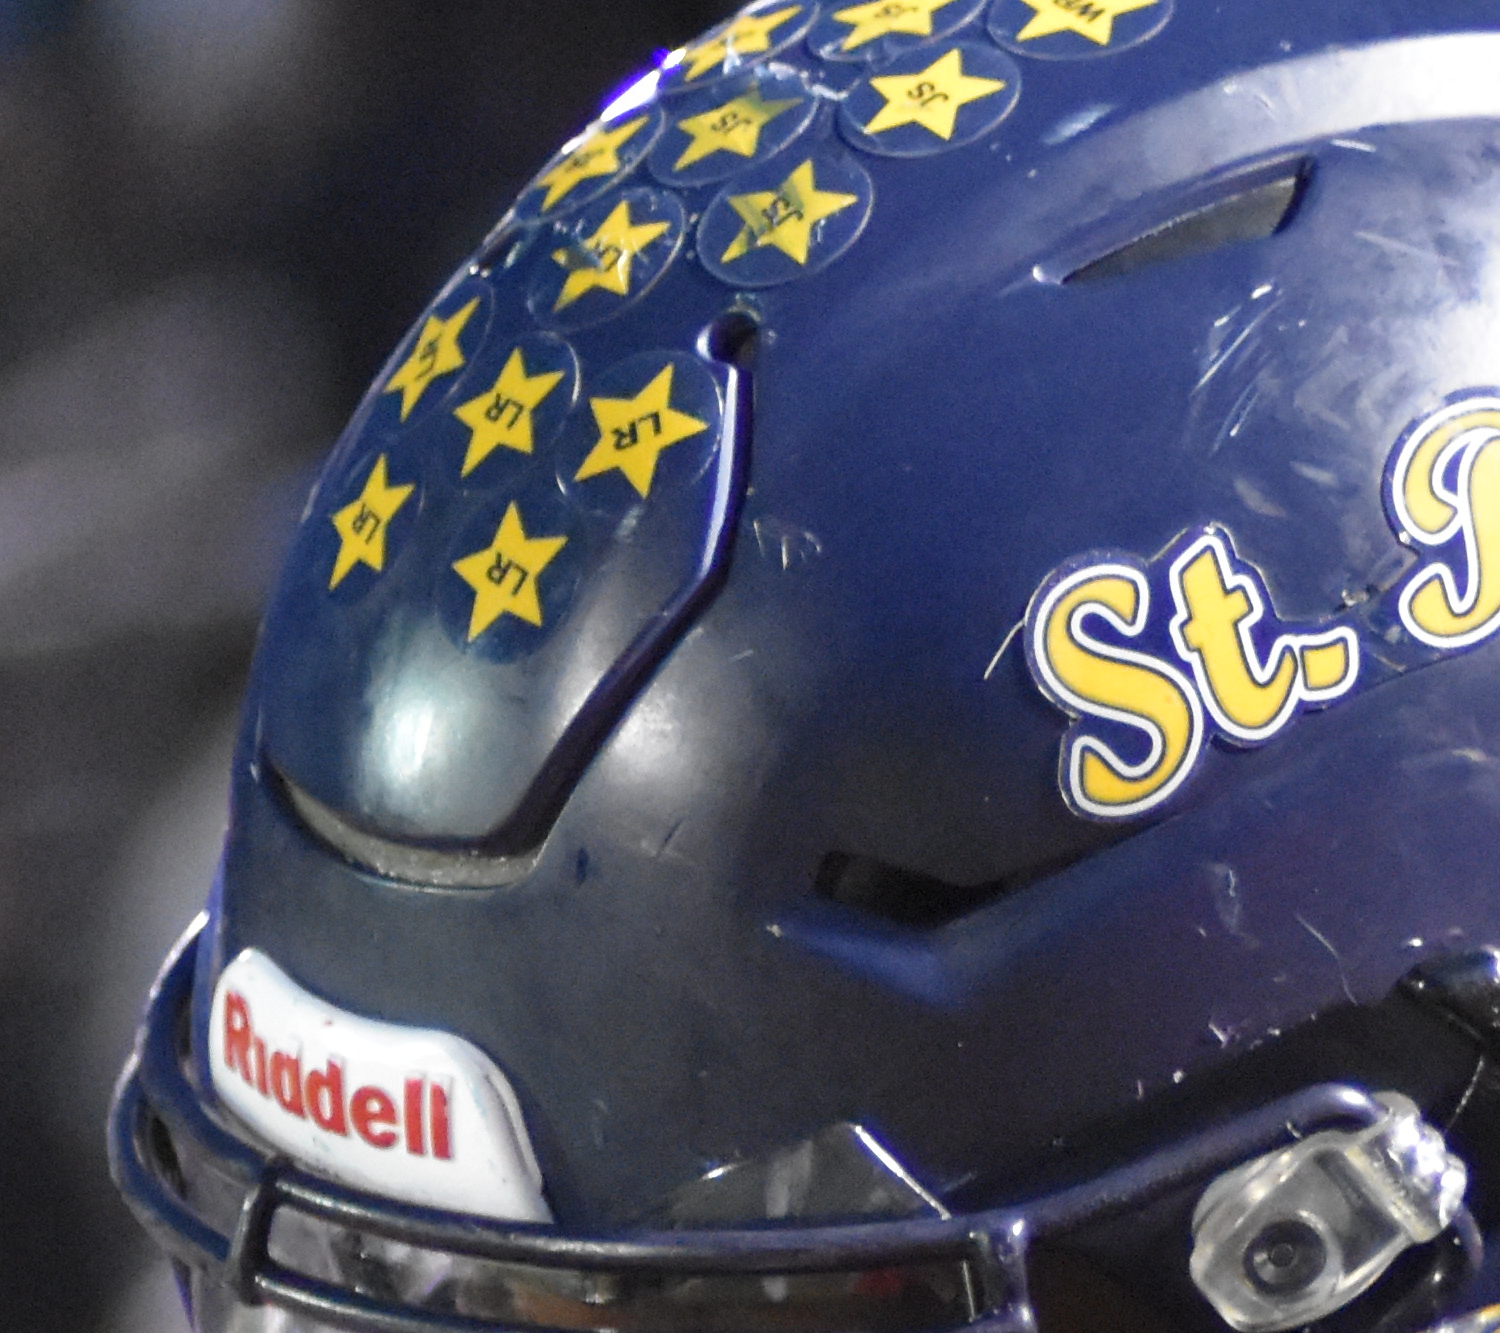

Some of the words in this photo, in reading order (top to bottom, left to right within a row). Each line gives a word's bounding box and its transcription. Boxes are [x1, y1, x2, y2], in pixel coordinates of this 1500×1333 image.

[484, 391, 525, 431] LR
[610, 410, 663, 451] LR
[351, 503, 381, 546] LR
[485, 551, 530, 596] LR
[1032, 531, 1358, 816] St.
